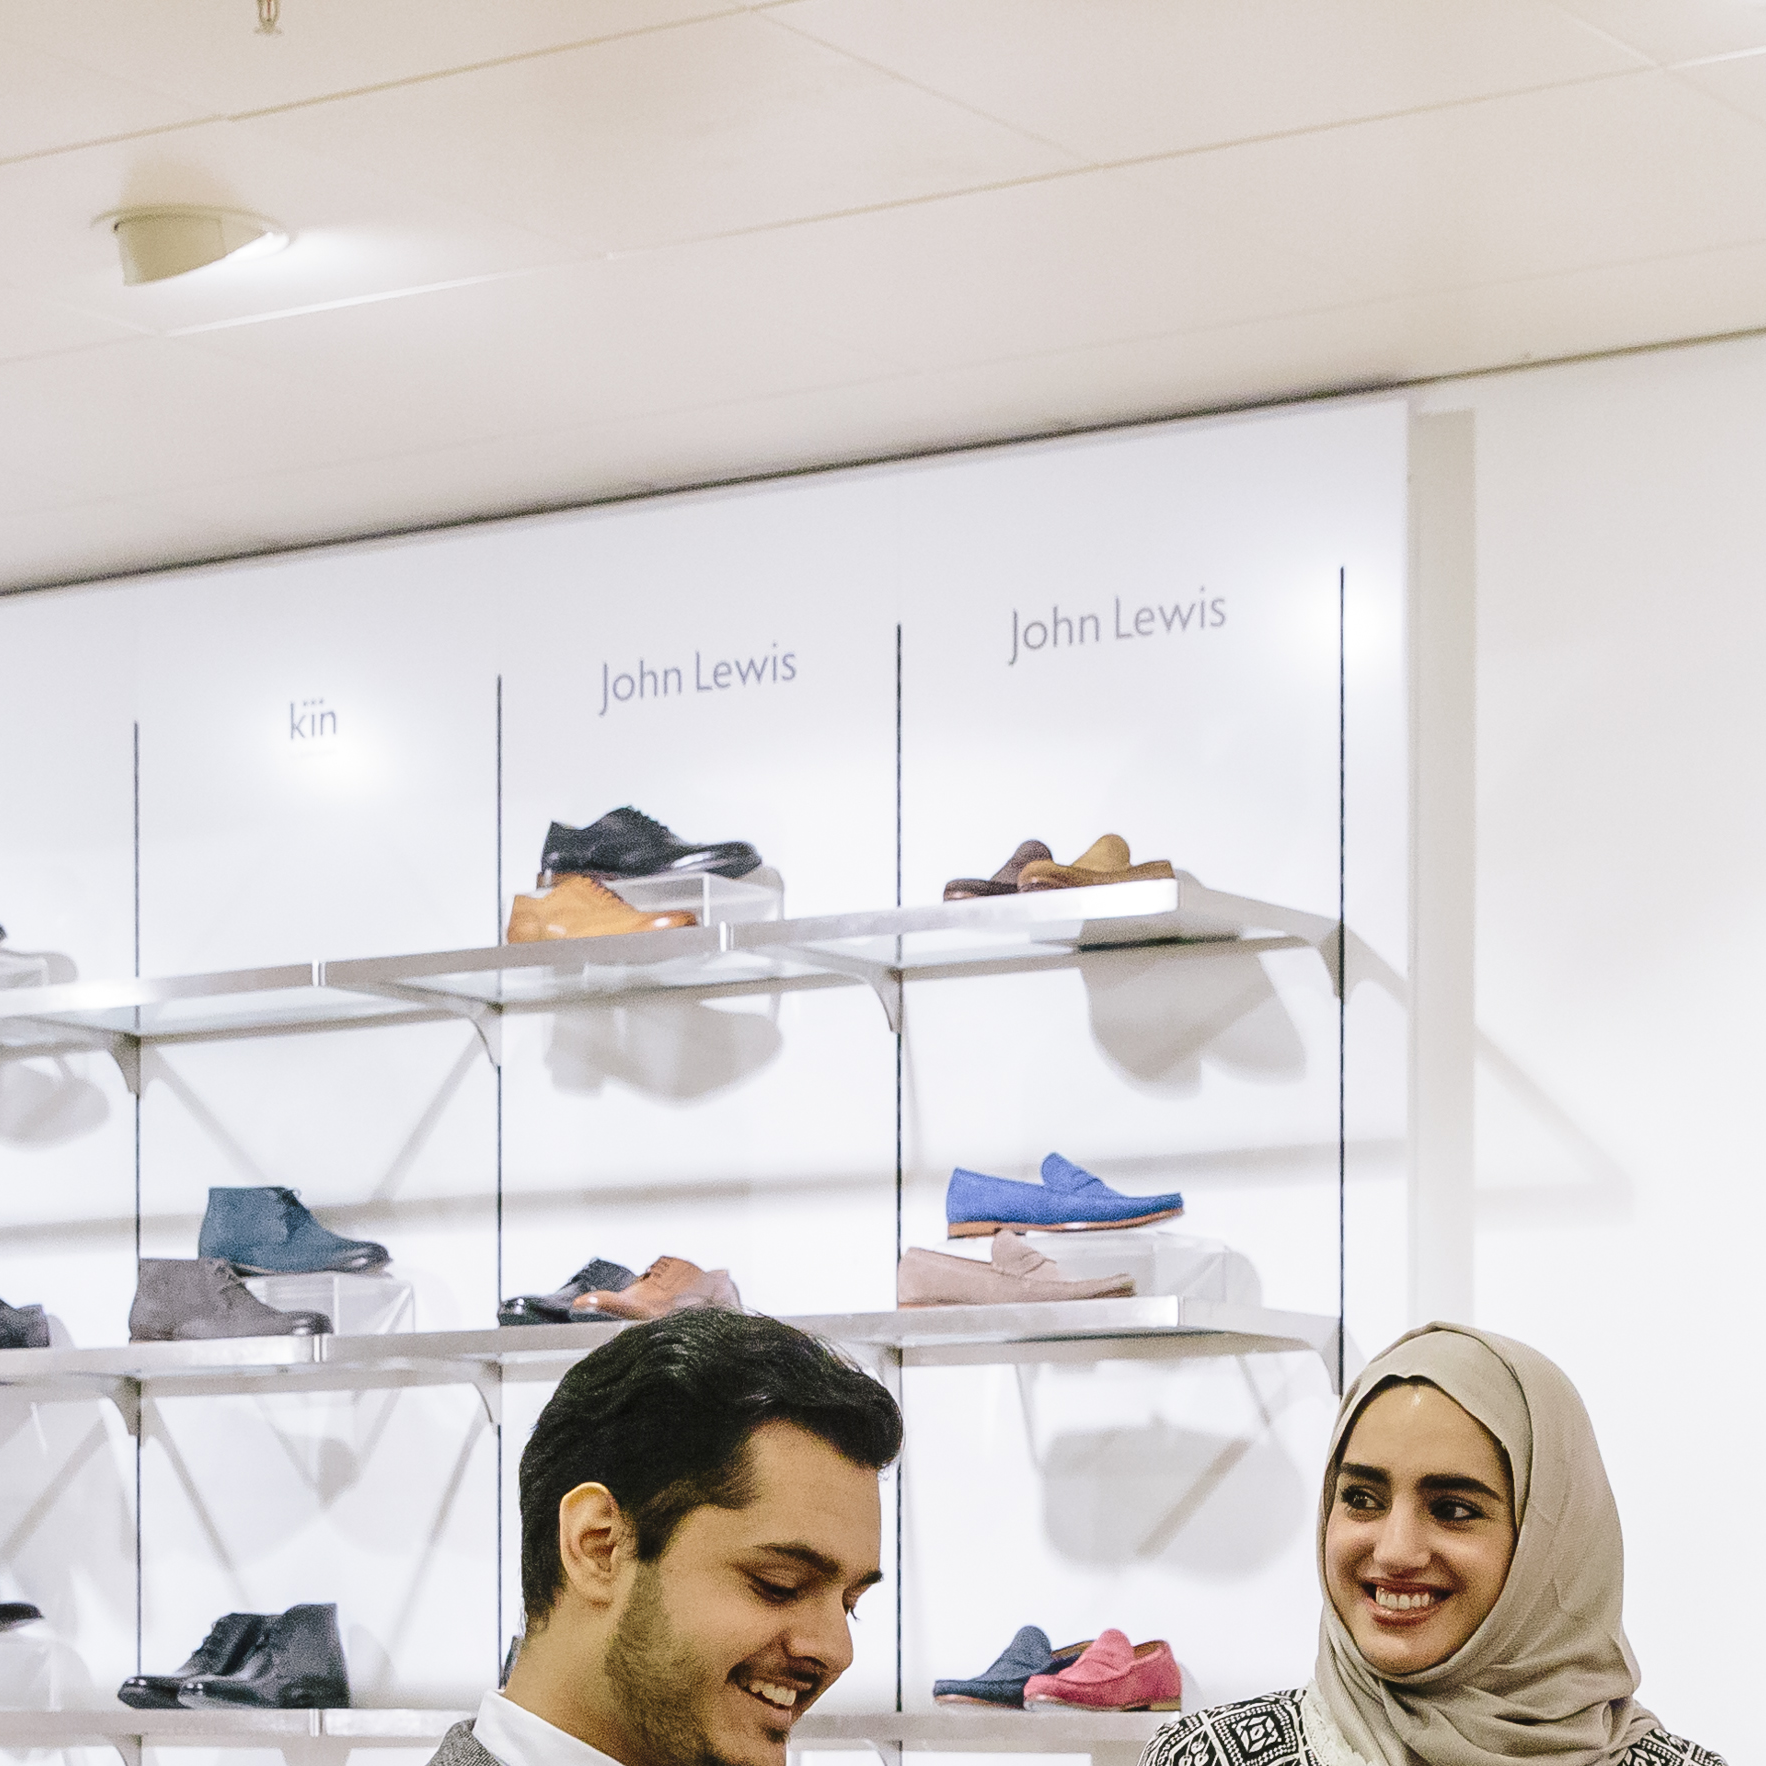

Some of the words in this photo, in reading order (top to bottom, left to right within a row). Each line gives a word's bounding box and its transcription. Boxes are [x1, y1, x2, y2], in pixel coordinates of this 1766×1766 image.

[1008, 607, 1101, 667] John
[1114, 584, 1227, 640] Lewis
[598, 660, 682, 717] John
[694, 641, 797, 692] Lewis
[289, 698, 337, 740] kin
